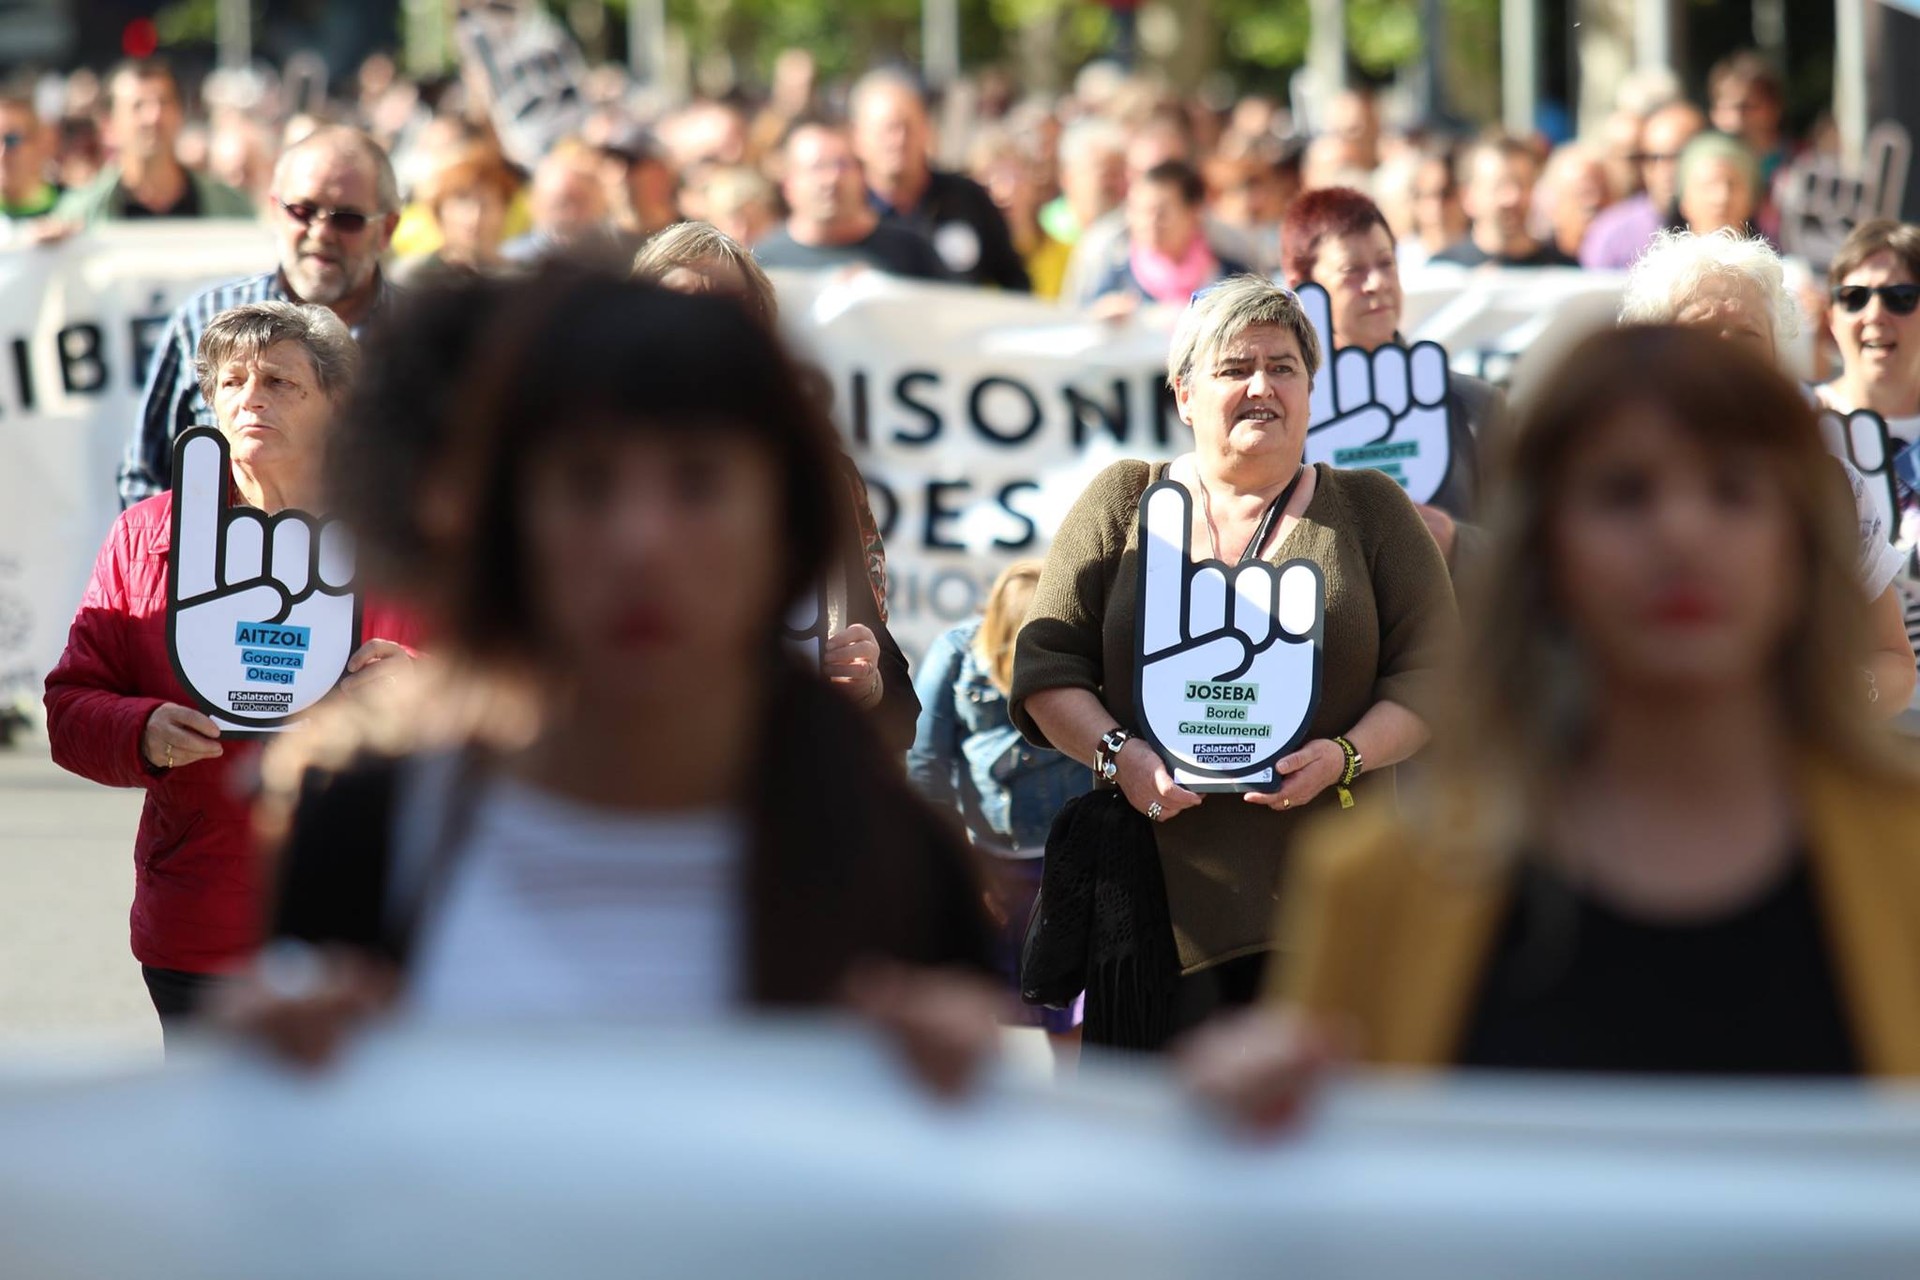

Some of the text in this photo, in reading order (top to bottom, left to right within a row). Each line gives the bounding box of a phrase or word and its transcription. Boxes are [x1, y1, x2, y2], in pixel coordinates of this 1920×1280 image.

[238, 628, 306, 647] AITZOL
[242, 651, 301, 666] Gogorza
[247, 668, 293, 684] Otaegi
[229, 692, 292, 702] #SalatzenDut
[1186, 685, 1256, 701] JOSEBA
[233, 703, 288, 712] #YoDenuncio
[1206, 706, 1245, 719] Borde
[1178, 722, 1270, 737] Gaztelumendi
[1194, 744, 1255, 753] #SalatzenDut
[1198, 755, 1250, 763] #YoDenuncio
